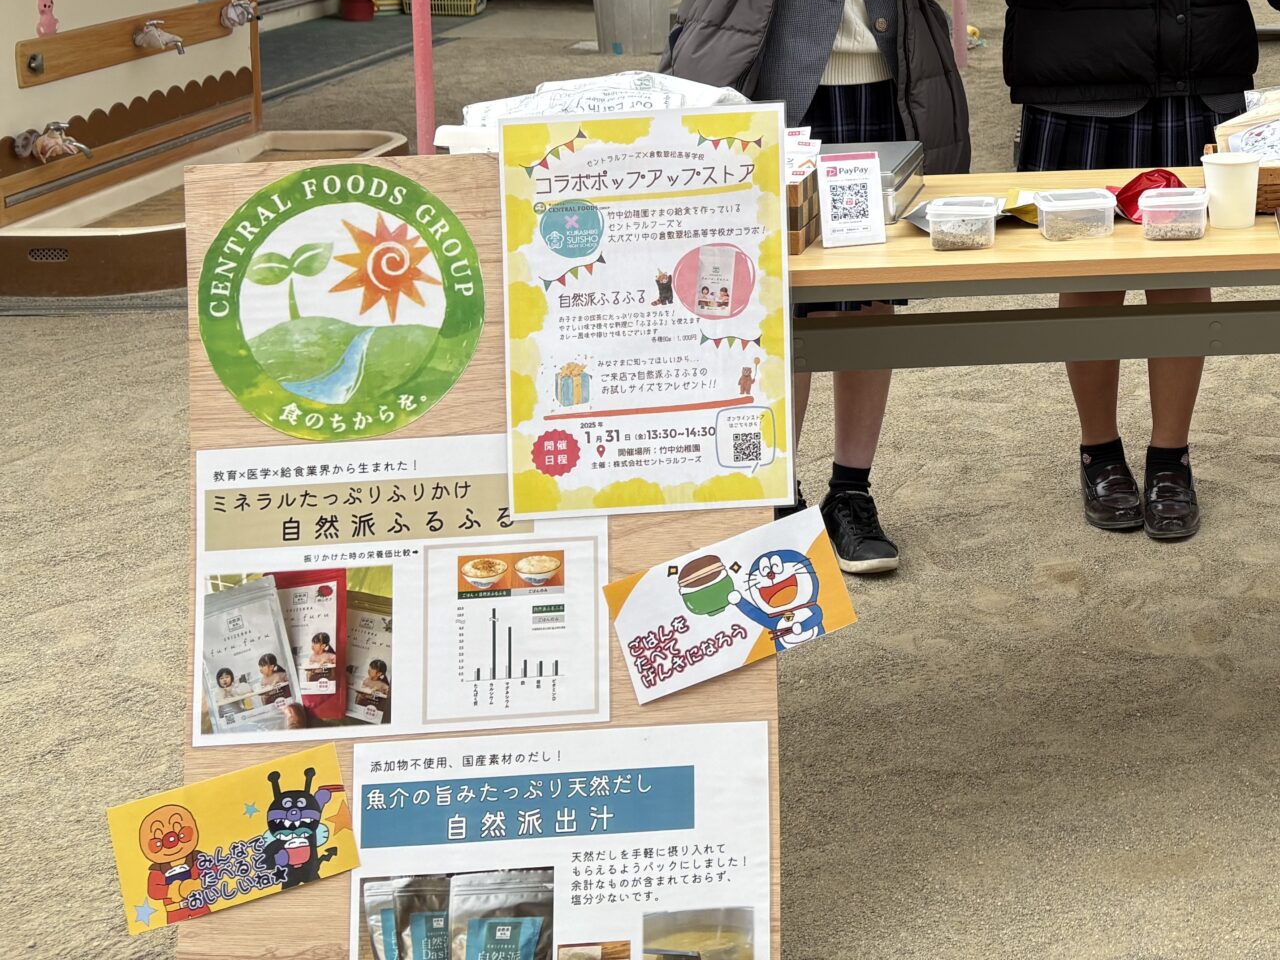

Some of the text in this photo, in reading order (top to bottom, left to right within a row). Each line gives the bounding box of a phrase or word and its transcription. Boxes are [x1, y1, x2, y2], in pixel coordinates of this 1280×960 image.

[535, 163, 756, 195] コラボポップアップストア
[838, 166, 869, 175] PayPay
[607, 203, 741, 220] 竹中幼稚園さまの給食を作っている
[608, 219, 682, 231] セントラルフーズと
[209, 174, 474, 318] CENTRAL FOODS GROUP
[566, 235, 599, 244] SUISHO
[558, 290, 646, 308] 自然派ふるふる
[601, 367, 708, 383] ご来店で自然派ふるふるの
[544, 440, 568, 451] 開催
[213, 459, 418, 483] 教育×医学×給食業界から生まれた！
[545, 455, 568, 465] 日程
[212, 480, 472, 514] ミネラルたっぷりふりかけ
[281, 505, 515, 543] 自然派ふるふる
[303, 548, 411, 564] 振りかけた時の栄養価比較
[628, 615, 690, 658] ごはんを
[634, 638, 682, 674] たべて
[641, 623, 748, 689] げんきになろう
[369, 750, 562, 774] 添加物不使用、国産素材のだし！
[366, 773, 653, 811] 魚介の旨みたっぷり天然だし
[446, 805, 615, 841] 自然派出汁
[195, 837, 265, 871] みんなで
[571, 843, 727, 863] 天然だしを手軽に摂り入れて
[199, 852, 268, 889] たべると
[570, 871, 733, 891] 余計なものが含まれておらず、
[570, 889, 663, 906] 塩分少ないです。
